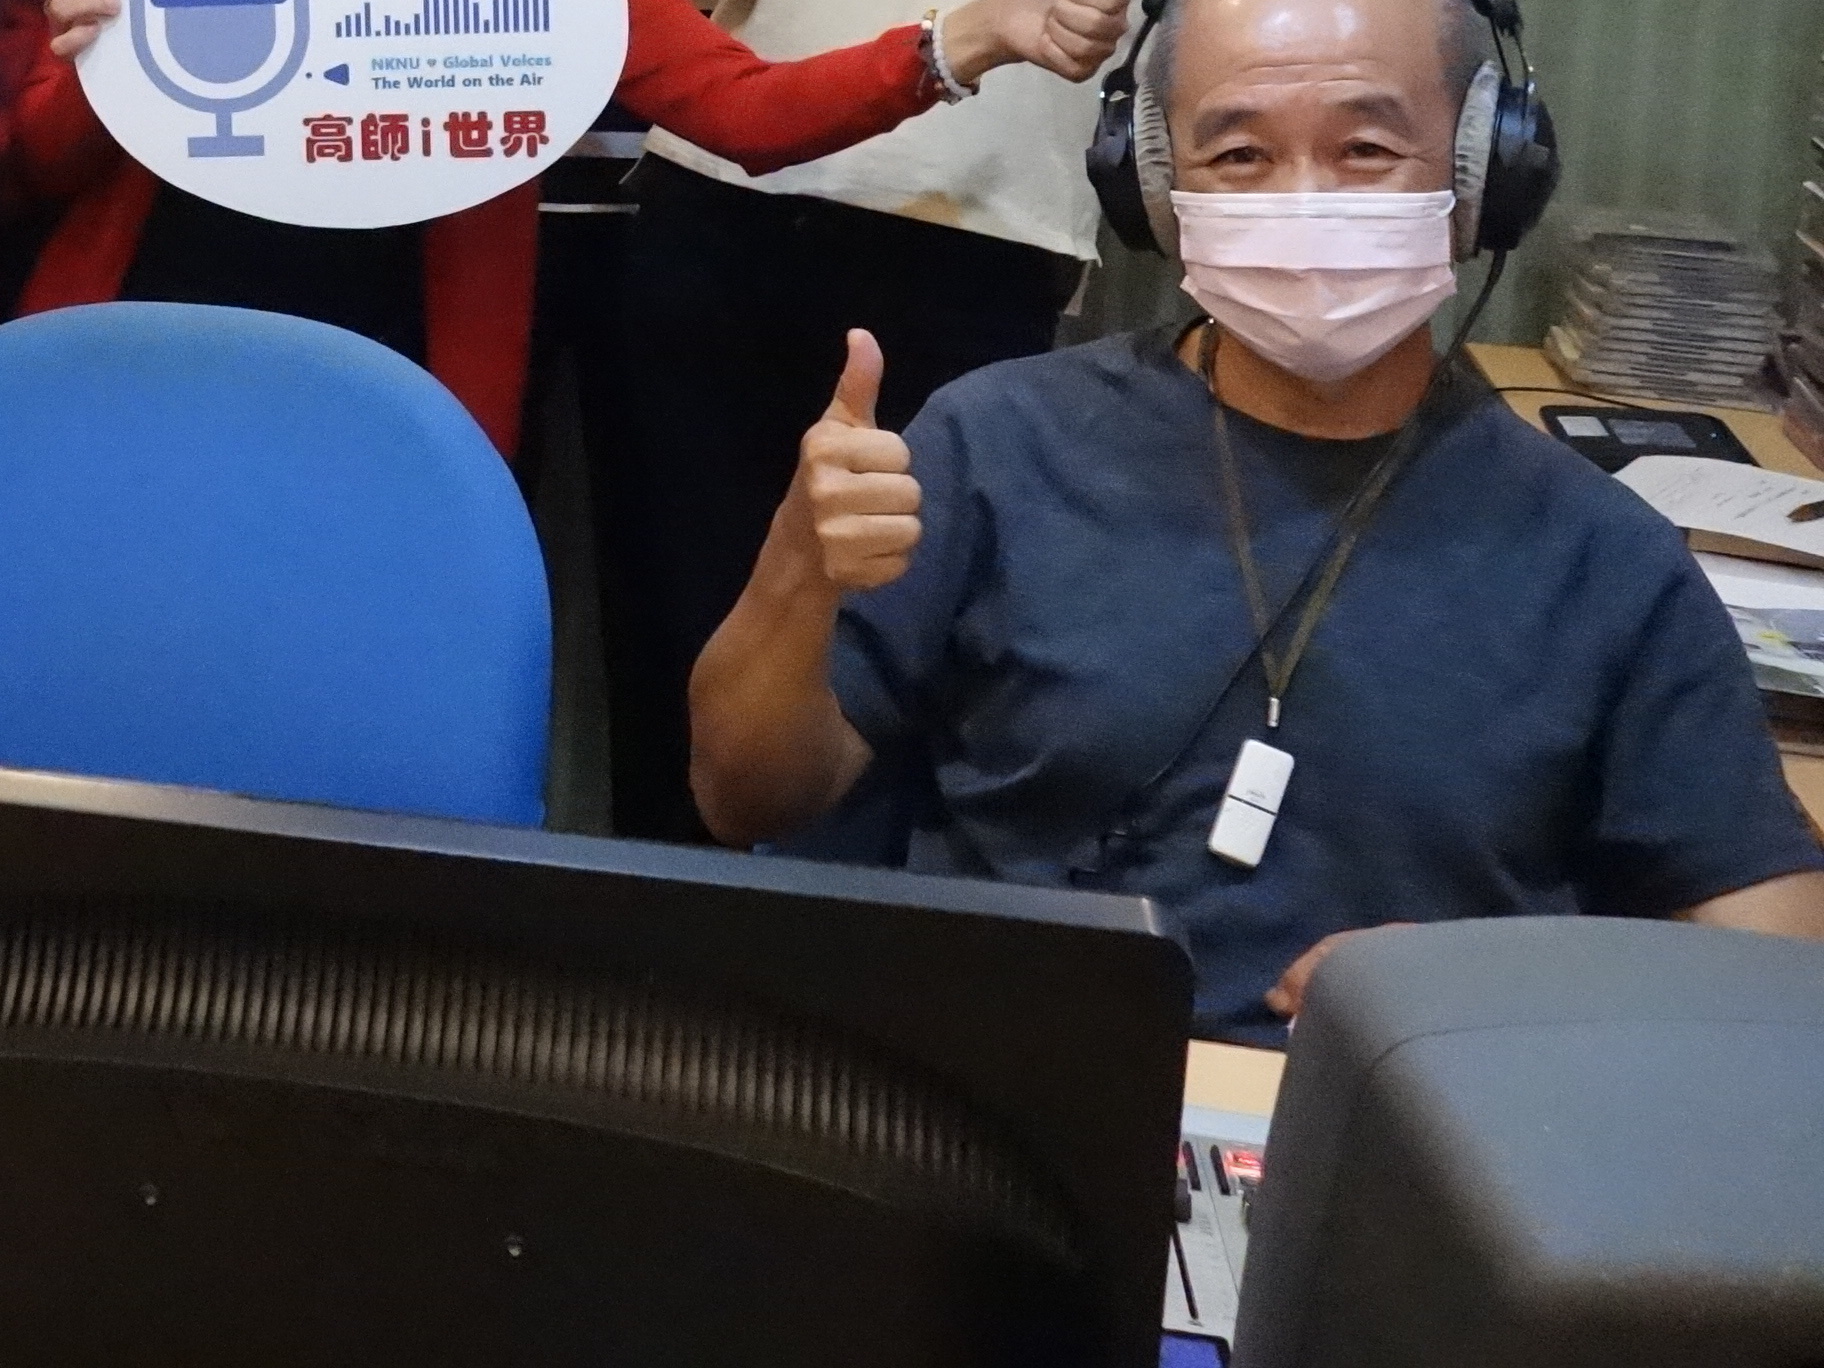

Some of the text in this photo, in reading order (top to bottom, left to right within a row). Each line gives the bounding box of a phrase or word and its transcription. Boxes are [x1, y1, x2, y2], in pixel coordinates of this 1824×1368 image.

[371, 53, 552, 71] NKNU Global Voices
[371, 72, 544, 90] The World on the Air
